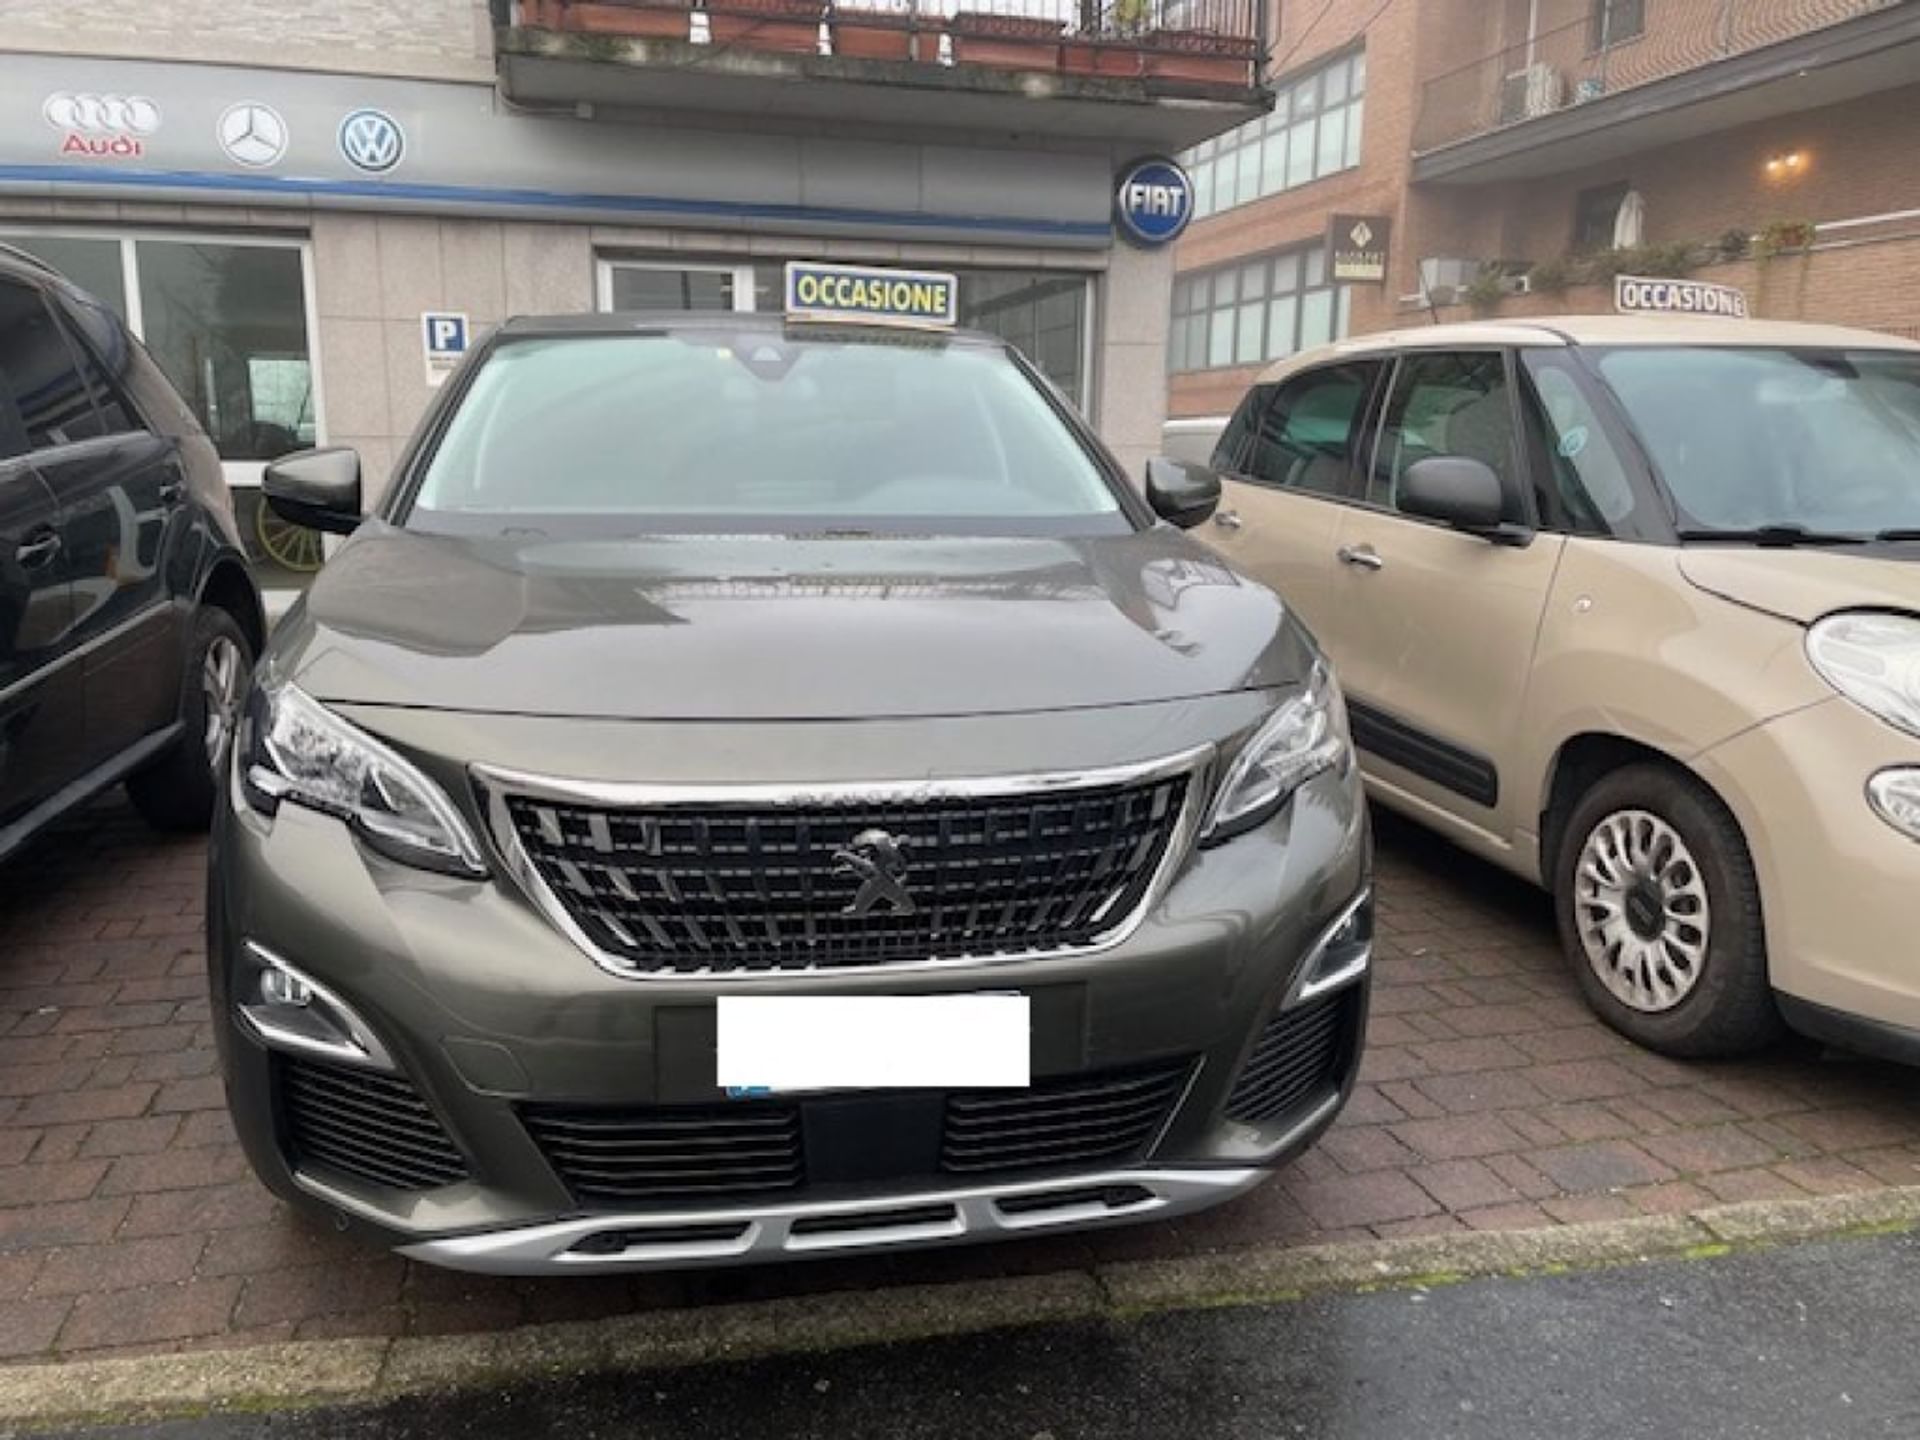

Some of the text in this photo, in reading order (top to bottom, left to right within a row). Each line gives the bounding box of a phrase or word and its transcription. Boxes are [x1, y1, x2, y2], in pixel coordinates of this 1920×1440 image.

[62, 134, 142, 155] Audi
[1129, 183, 1184, 216] FIAT
[797, 273, 947, 314] OCCASIONE
[1622, 282, 1746, 318] OCCASIONE
[434, 320, 457, 350] P
